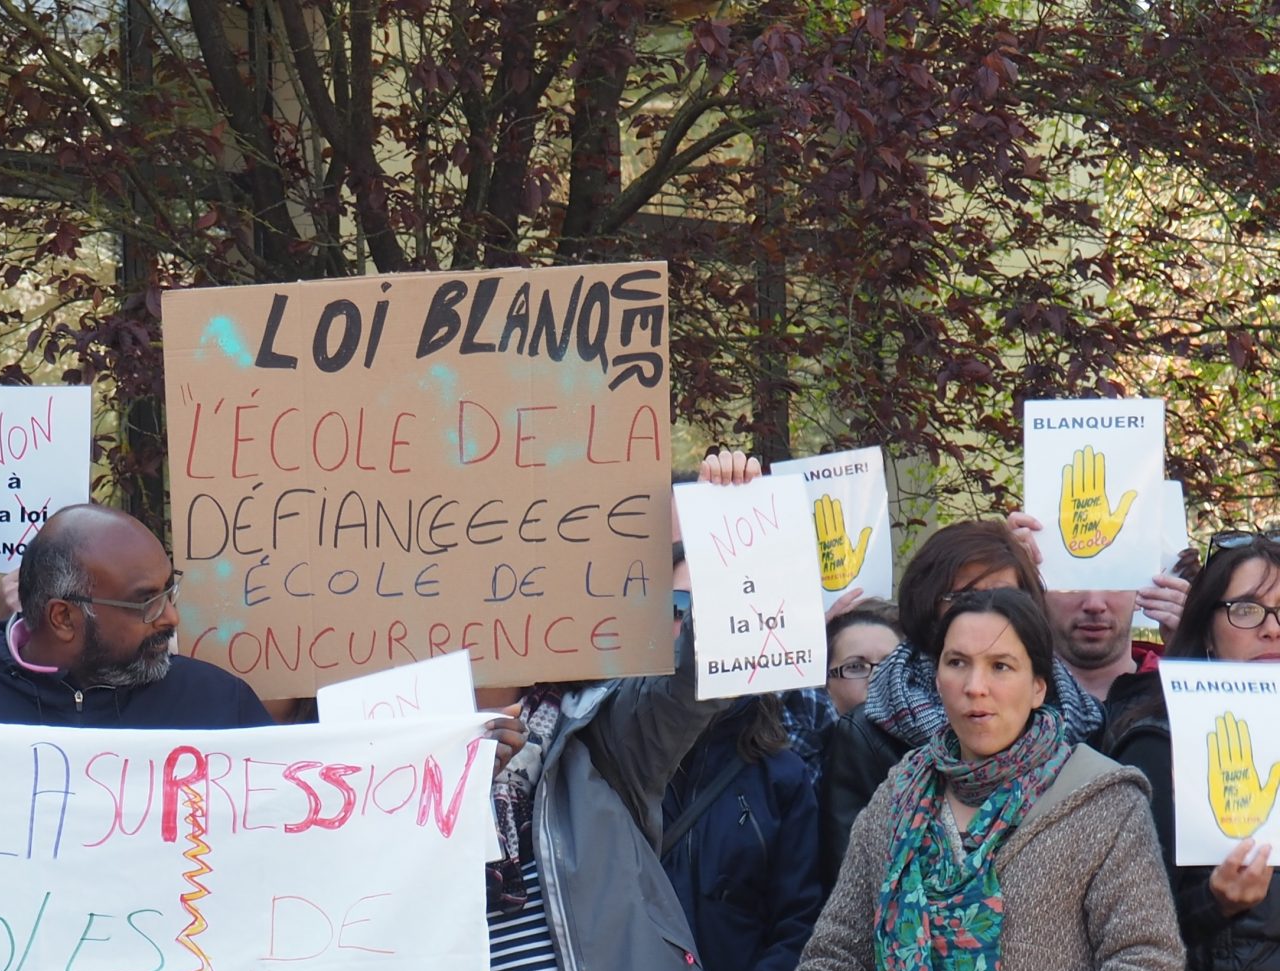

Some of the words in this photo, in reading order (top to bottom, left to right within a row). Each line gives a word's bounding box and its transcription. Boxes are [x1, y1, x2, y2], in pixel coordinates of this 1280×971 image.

[1033, 416, 1145, 430] BLANQUER!
[458, 399, 558, 468] DE
[586, 404, 661, 464] LA
[8, 472, 21, 489] à
[1072, 495, 1102, 510] TOUCHE
[20, 505, 48, 523] loi
[1072, 510, 1089, 523] PAS
[710, 492, 780, 567] NON
[1080, 519, 1101, 534] MON
[1070, 530, 1112, 551] école
[243, 554, 440, 607] ÉCOLE
[483, 564, 544, 602] DE
[585, 558, 650, 598] LA
[742, 575, 756, 594] à
[730, 615, 750, 634] la
[759, 610, 785, 632] loi
[708, 649, 812, 675] BLANQUER!
[1171, 679, 1277, 695] BLANQUER!
[258, 892, 397, 961] DE
